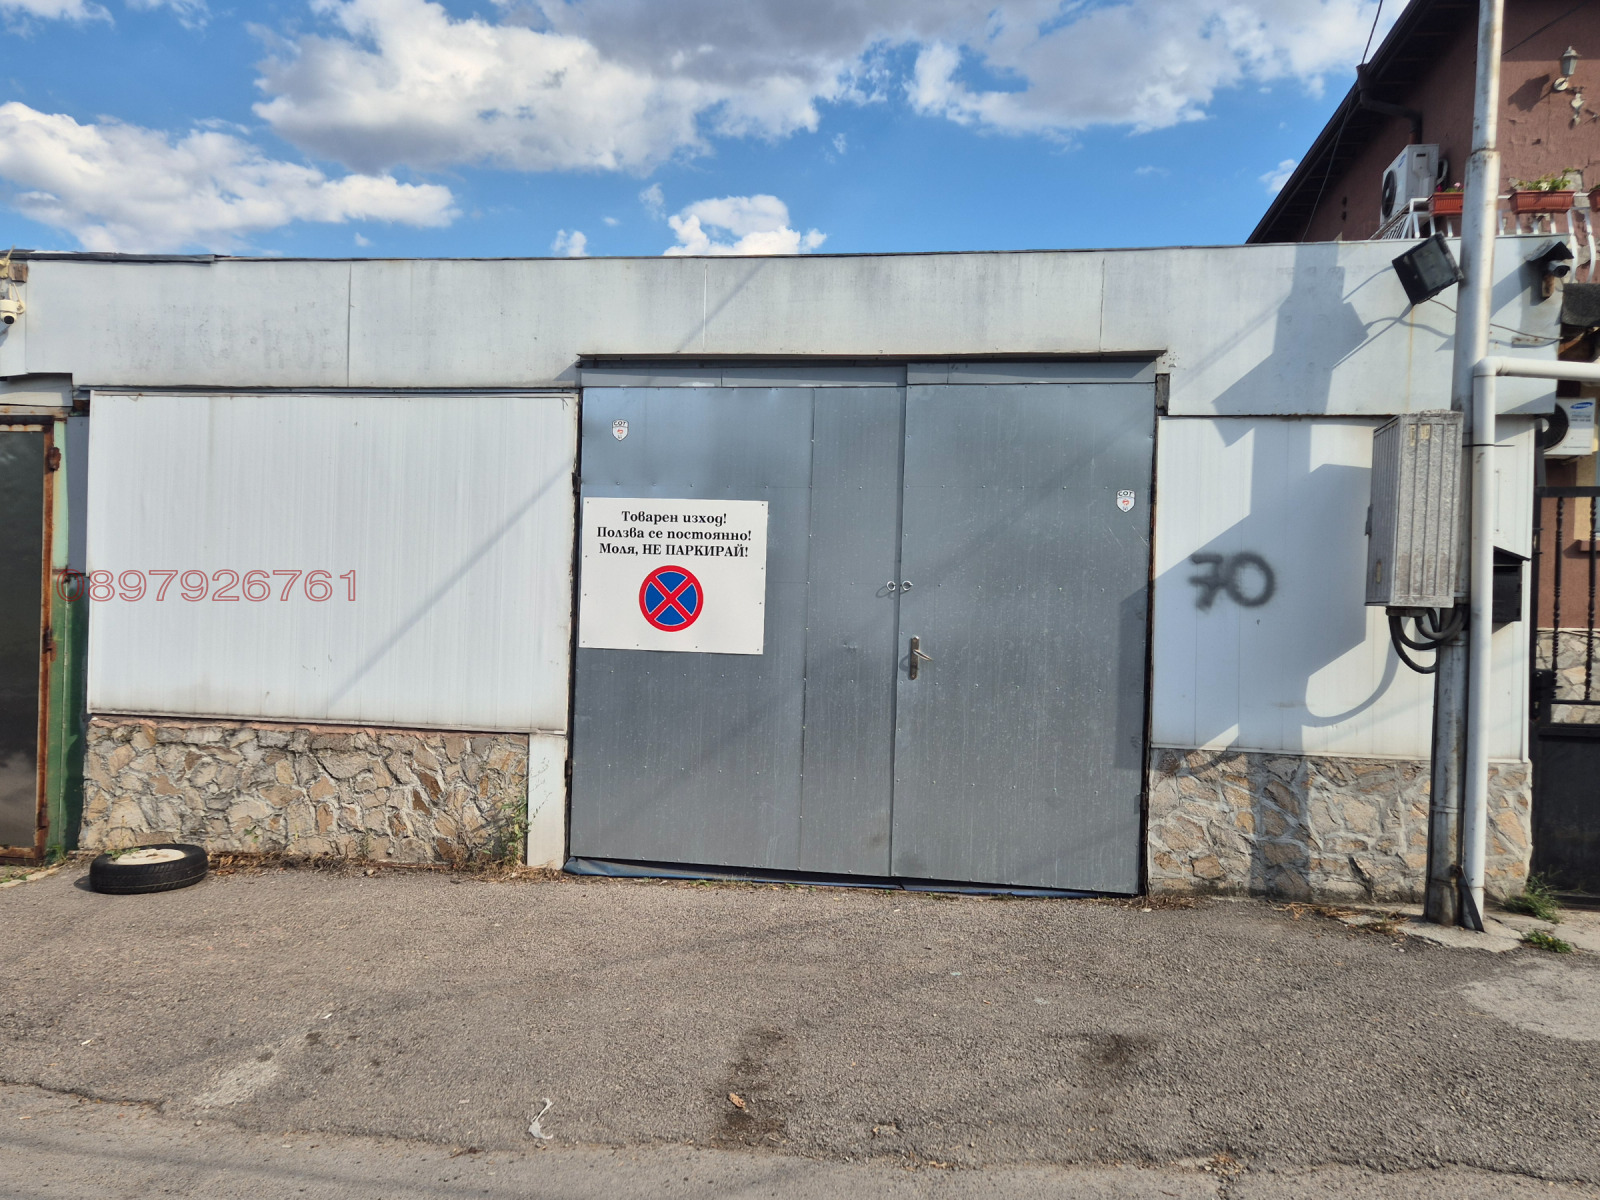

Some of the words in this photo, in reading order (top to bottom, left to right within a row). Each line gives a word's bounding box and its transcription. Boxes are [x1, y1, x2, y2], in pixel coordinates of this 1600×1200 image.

[622, 511, 678, 525] Товарен
[683, 513, 727, 527] изход!
[597, 527, 644, 538] Ползва
[648, 530, 663, 538] се
[667, 530, 752, 541] постоянно!
[599, 543, 638, 556] Моля,
[642, 544, 661, 555] НЕ
[665, 543, 749, 557] ПАРКИРАЙ!
